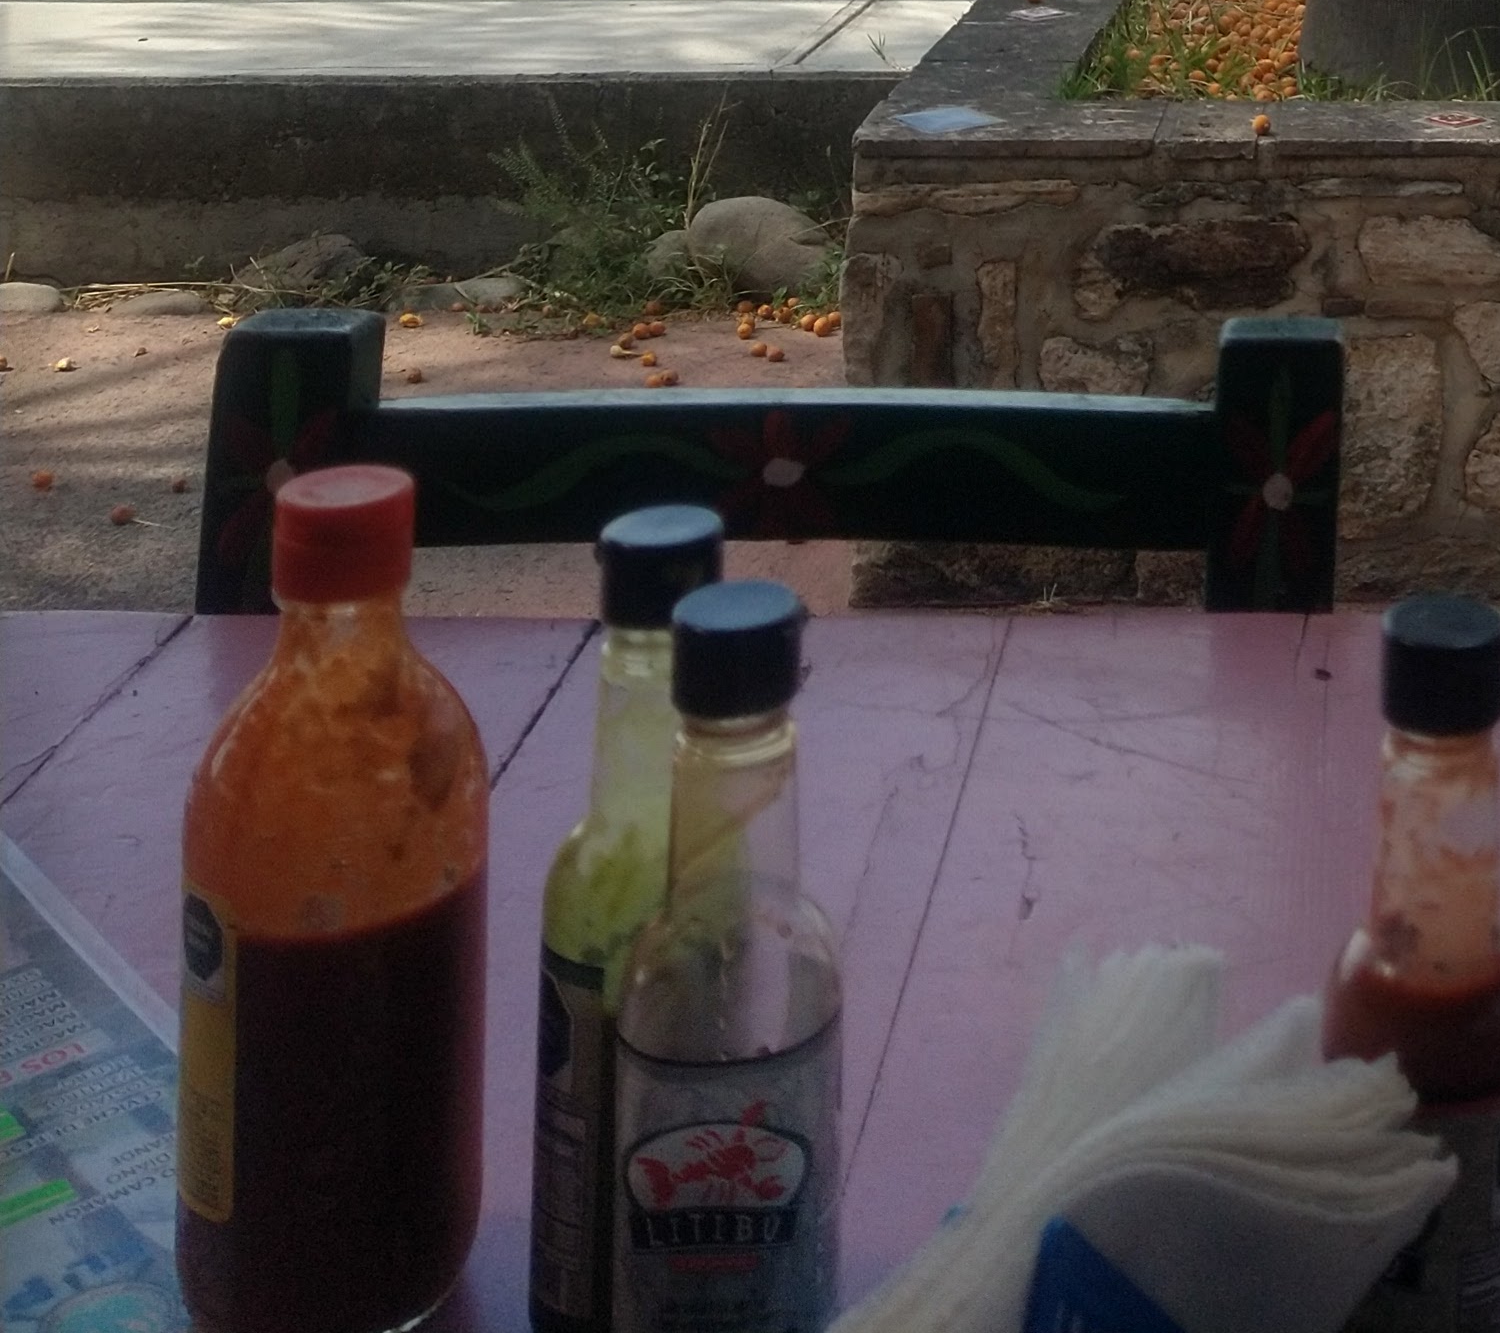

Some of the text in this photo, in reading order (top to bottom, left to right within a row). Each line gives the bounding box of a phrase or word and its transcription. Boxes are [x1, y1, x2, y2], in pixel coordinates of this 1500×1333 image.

[21, 1043, 84, 1072] LOS
[111, 1134, 175, 1165] RANDE
[106, 1152, 171, 1185] DIANO
